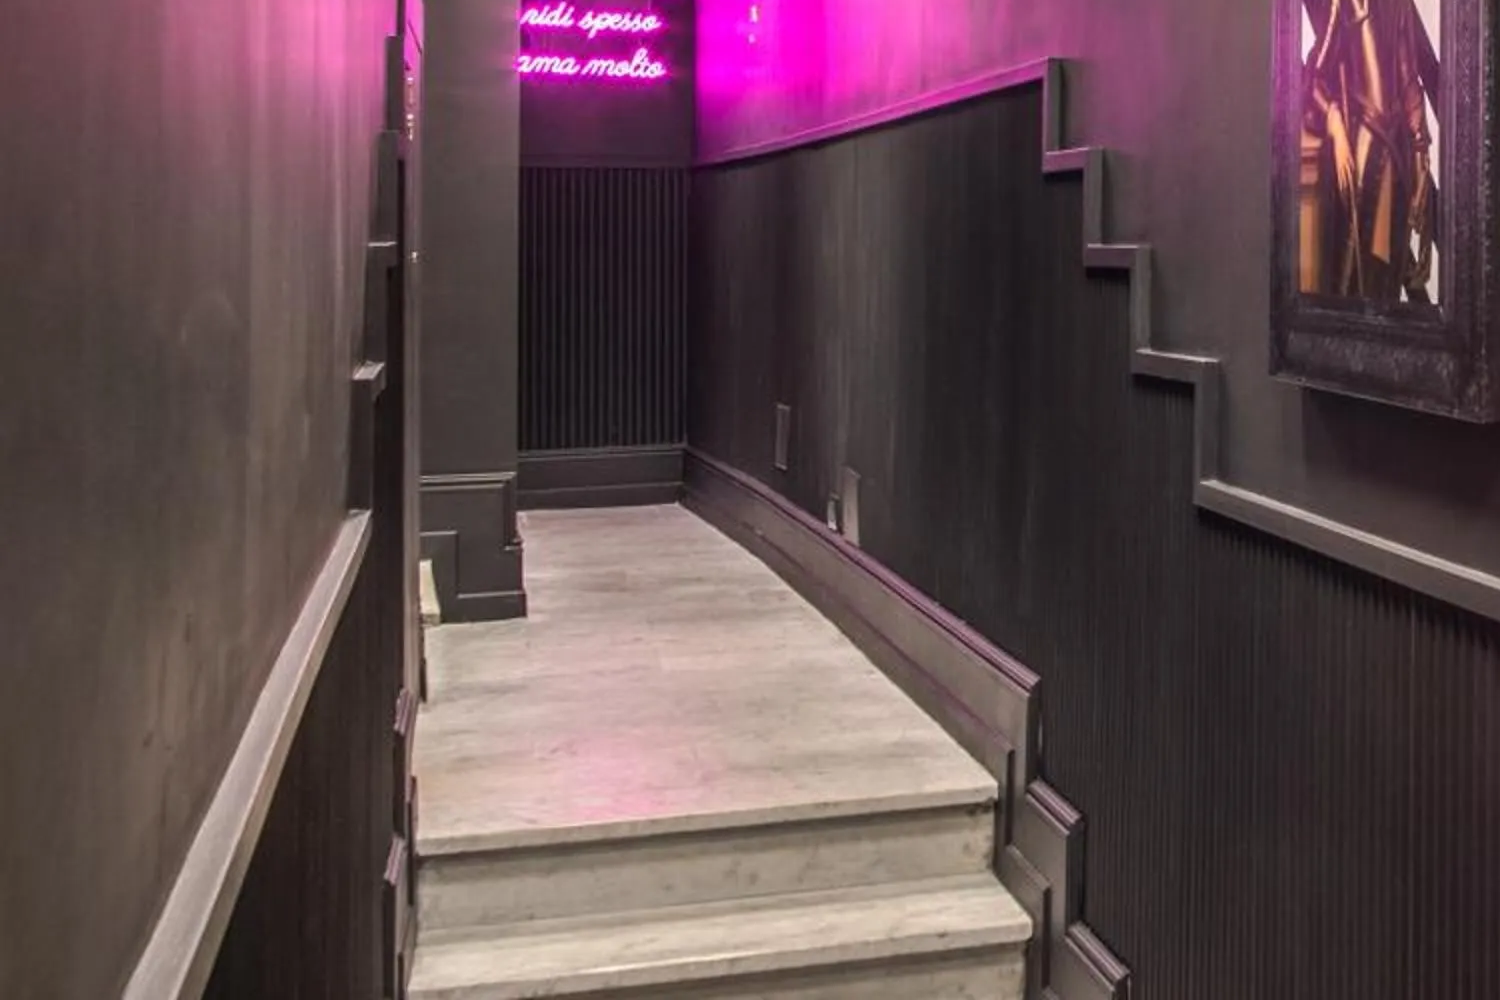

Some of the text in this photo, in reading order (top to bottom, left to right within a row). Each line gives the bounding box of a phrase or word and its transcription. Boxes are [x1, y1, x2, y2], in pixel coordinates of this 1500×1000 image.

[519, 1, 662, 39] ridi spesso
[516, 48, 666, 78] ama molto
